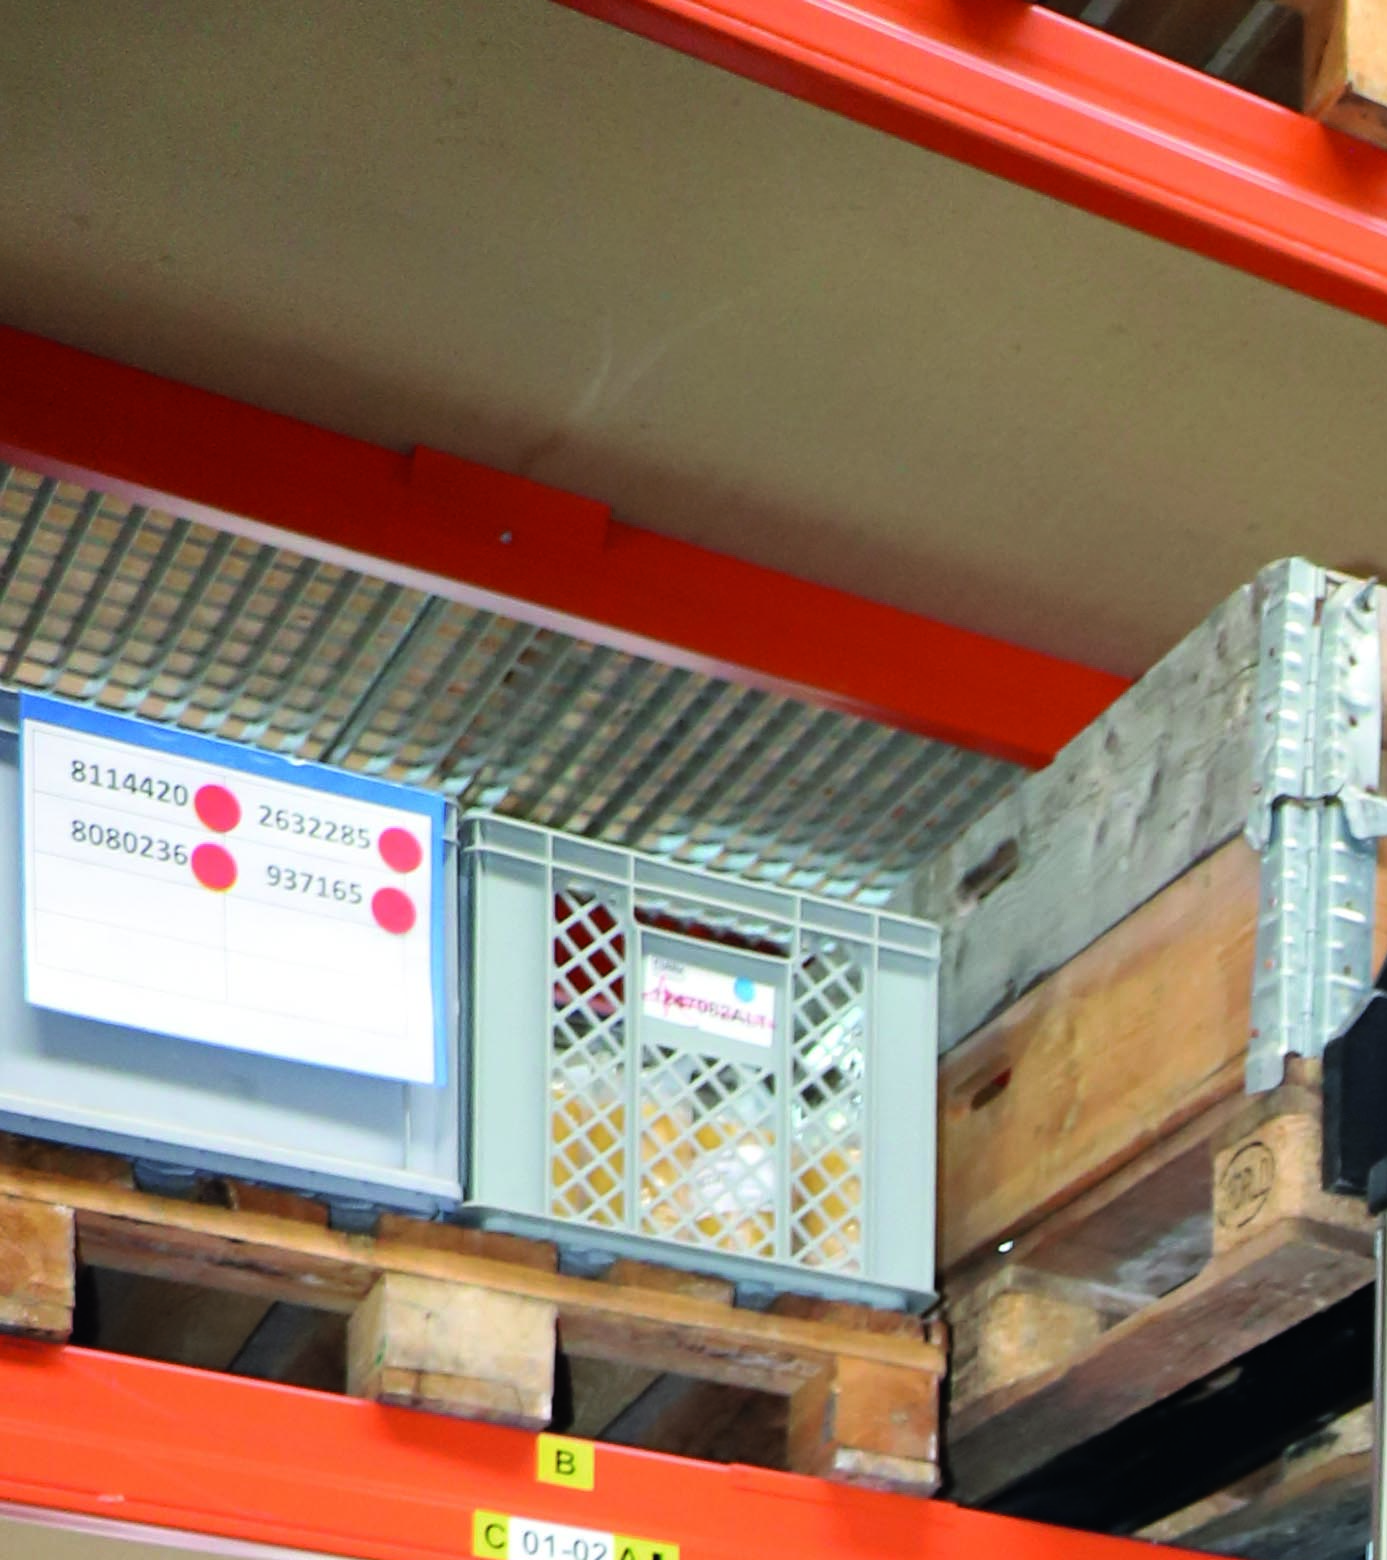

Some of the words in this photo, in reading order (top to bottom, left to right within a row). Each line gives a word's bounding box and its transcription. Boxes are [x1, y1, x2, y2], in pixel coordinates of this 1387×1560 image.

[71, 759, 188, 807] 8114420
[71, 819, 188, 866] 8080236
[258, 804, 371, 850] 2632285
[266, 864, 362, 905] 937165
[554, 1449, 577, 1477] B
[484, 1522, 507, 1550] C
